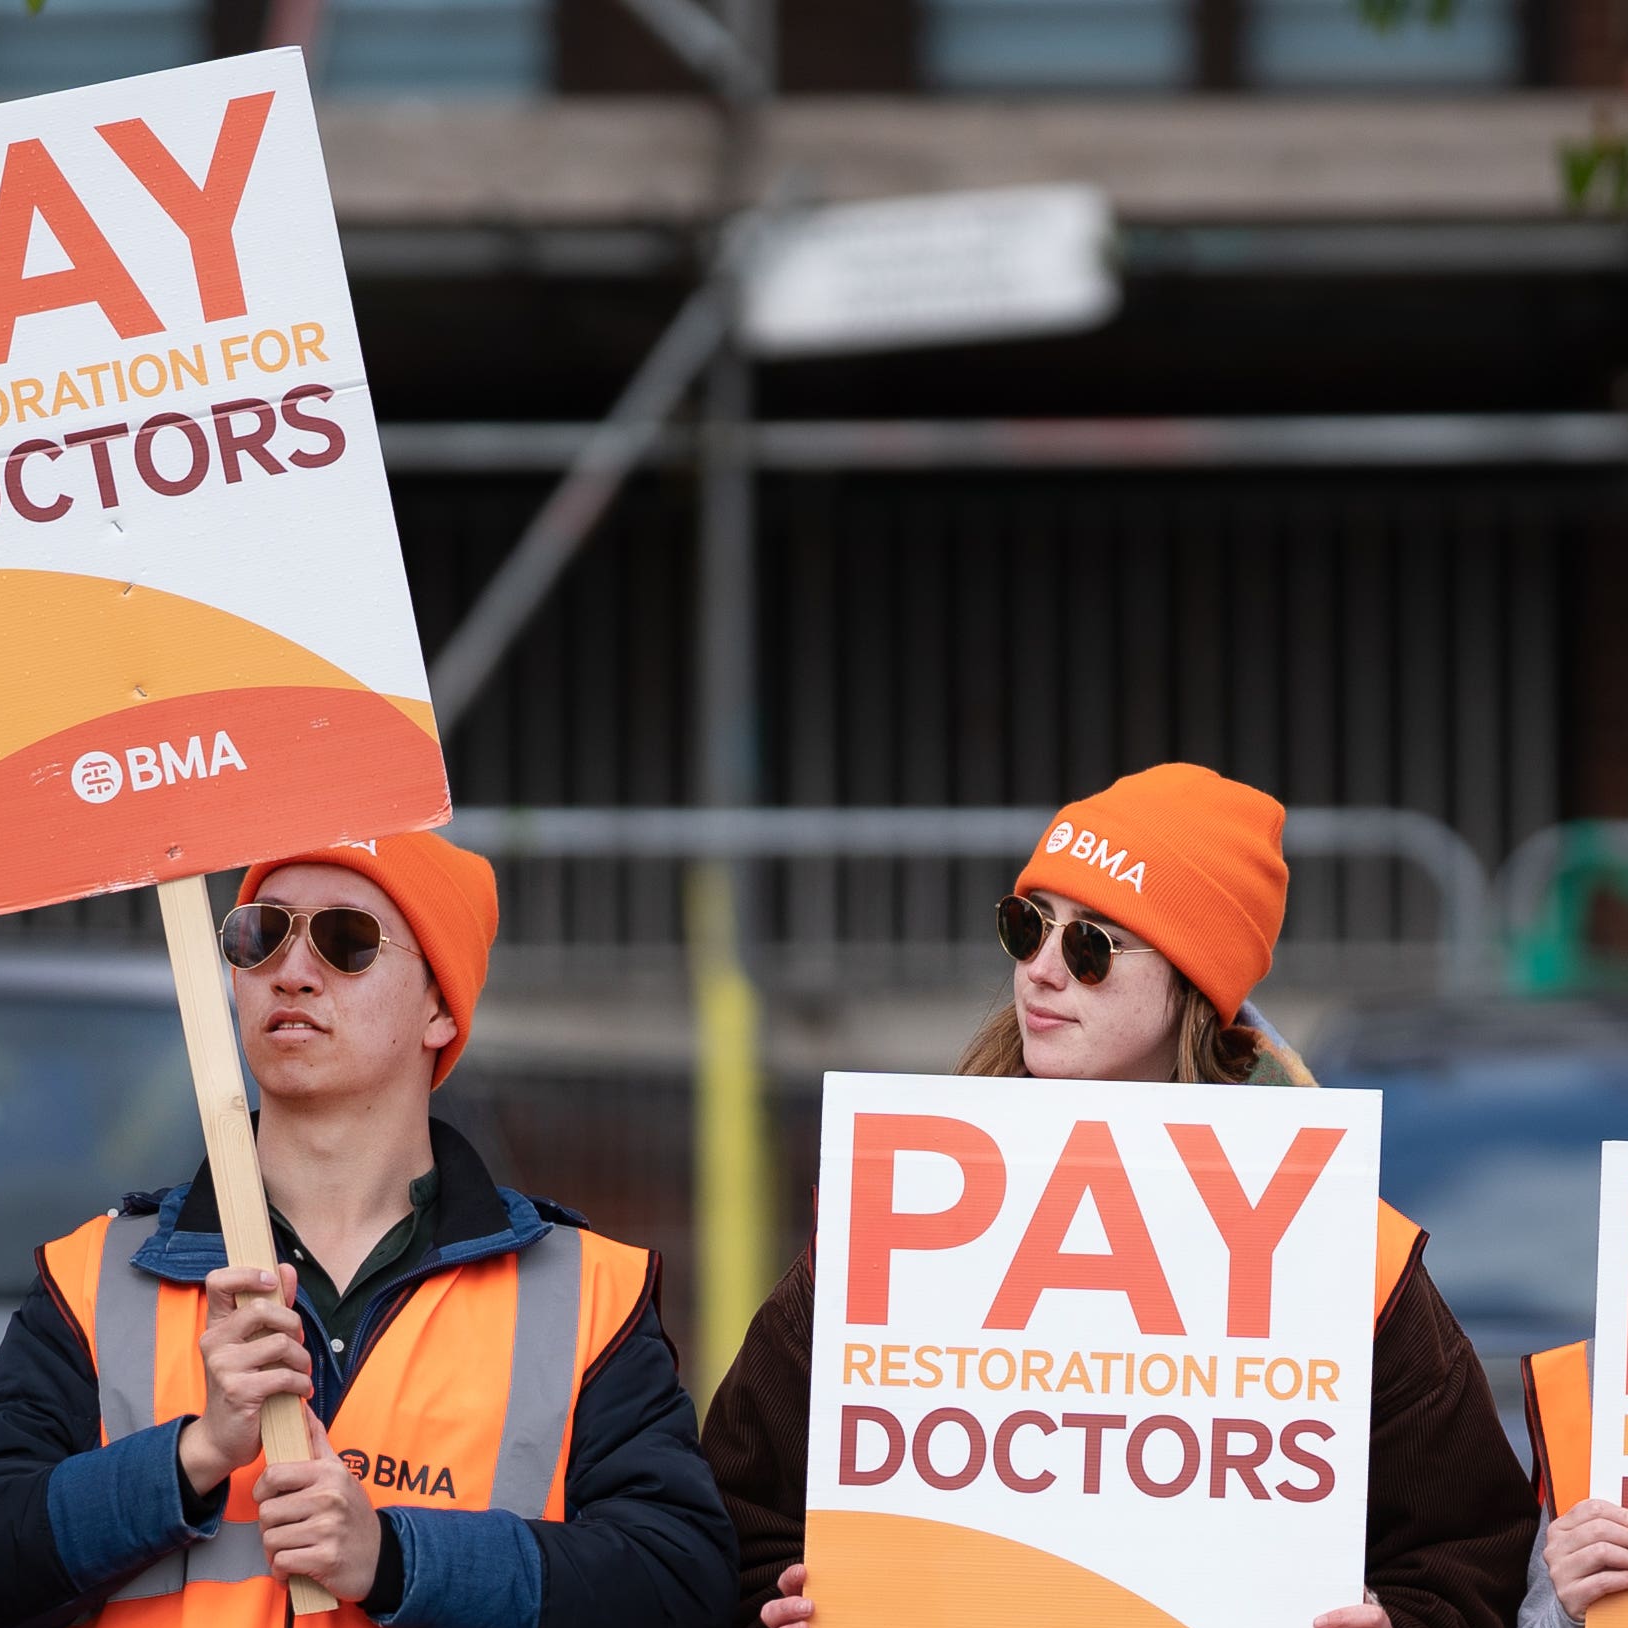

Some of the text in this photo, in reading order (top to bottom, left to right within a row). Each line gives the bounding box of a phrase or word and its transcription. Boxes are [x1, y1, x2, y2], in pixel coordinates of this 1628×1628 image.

[221, 321, 331, 382] FOR
[128, 730, 247, 792] BMA
[1070, 832, 1147, 894] BMA
[846, 1112, 1347, 1339] PAY
[843, 1343, 1340, 1402] RESTORATION FOR
[374, 1454, 456, 1499] BMA
[839, 1405, 1336, 1503] DOCTORS
